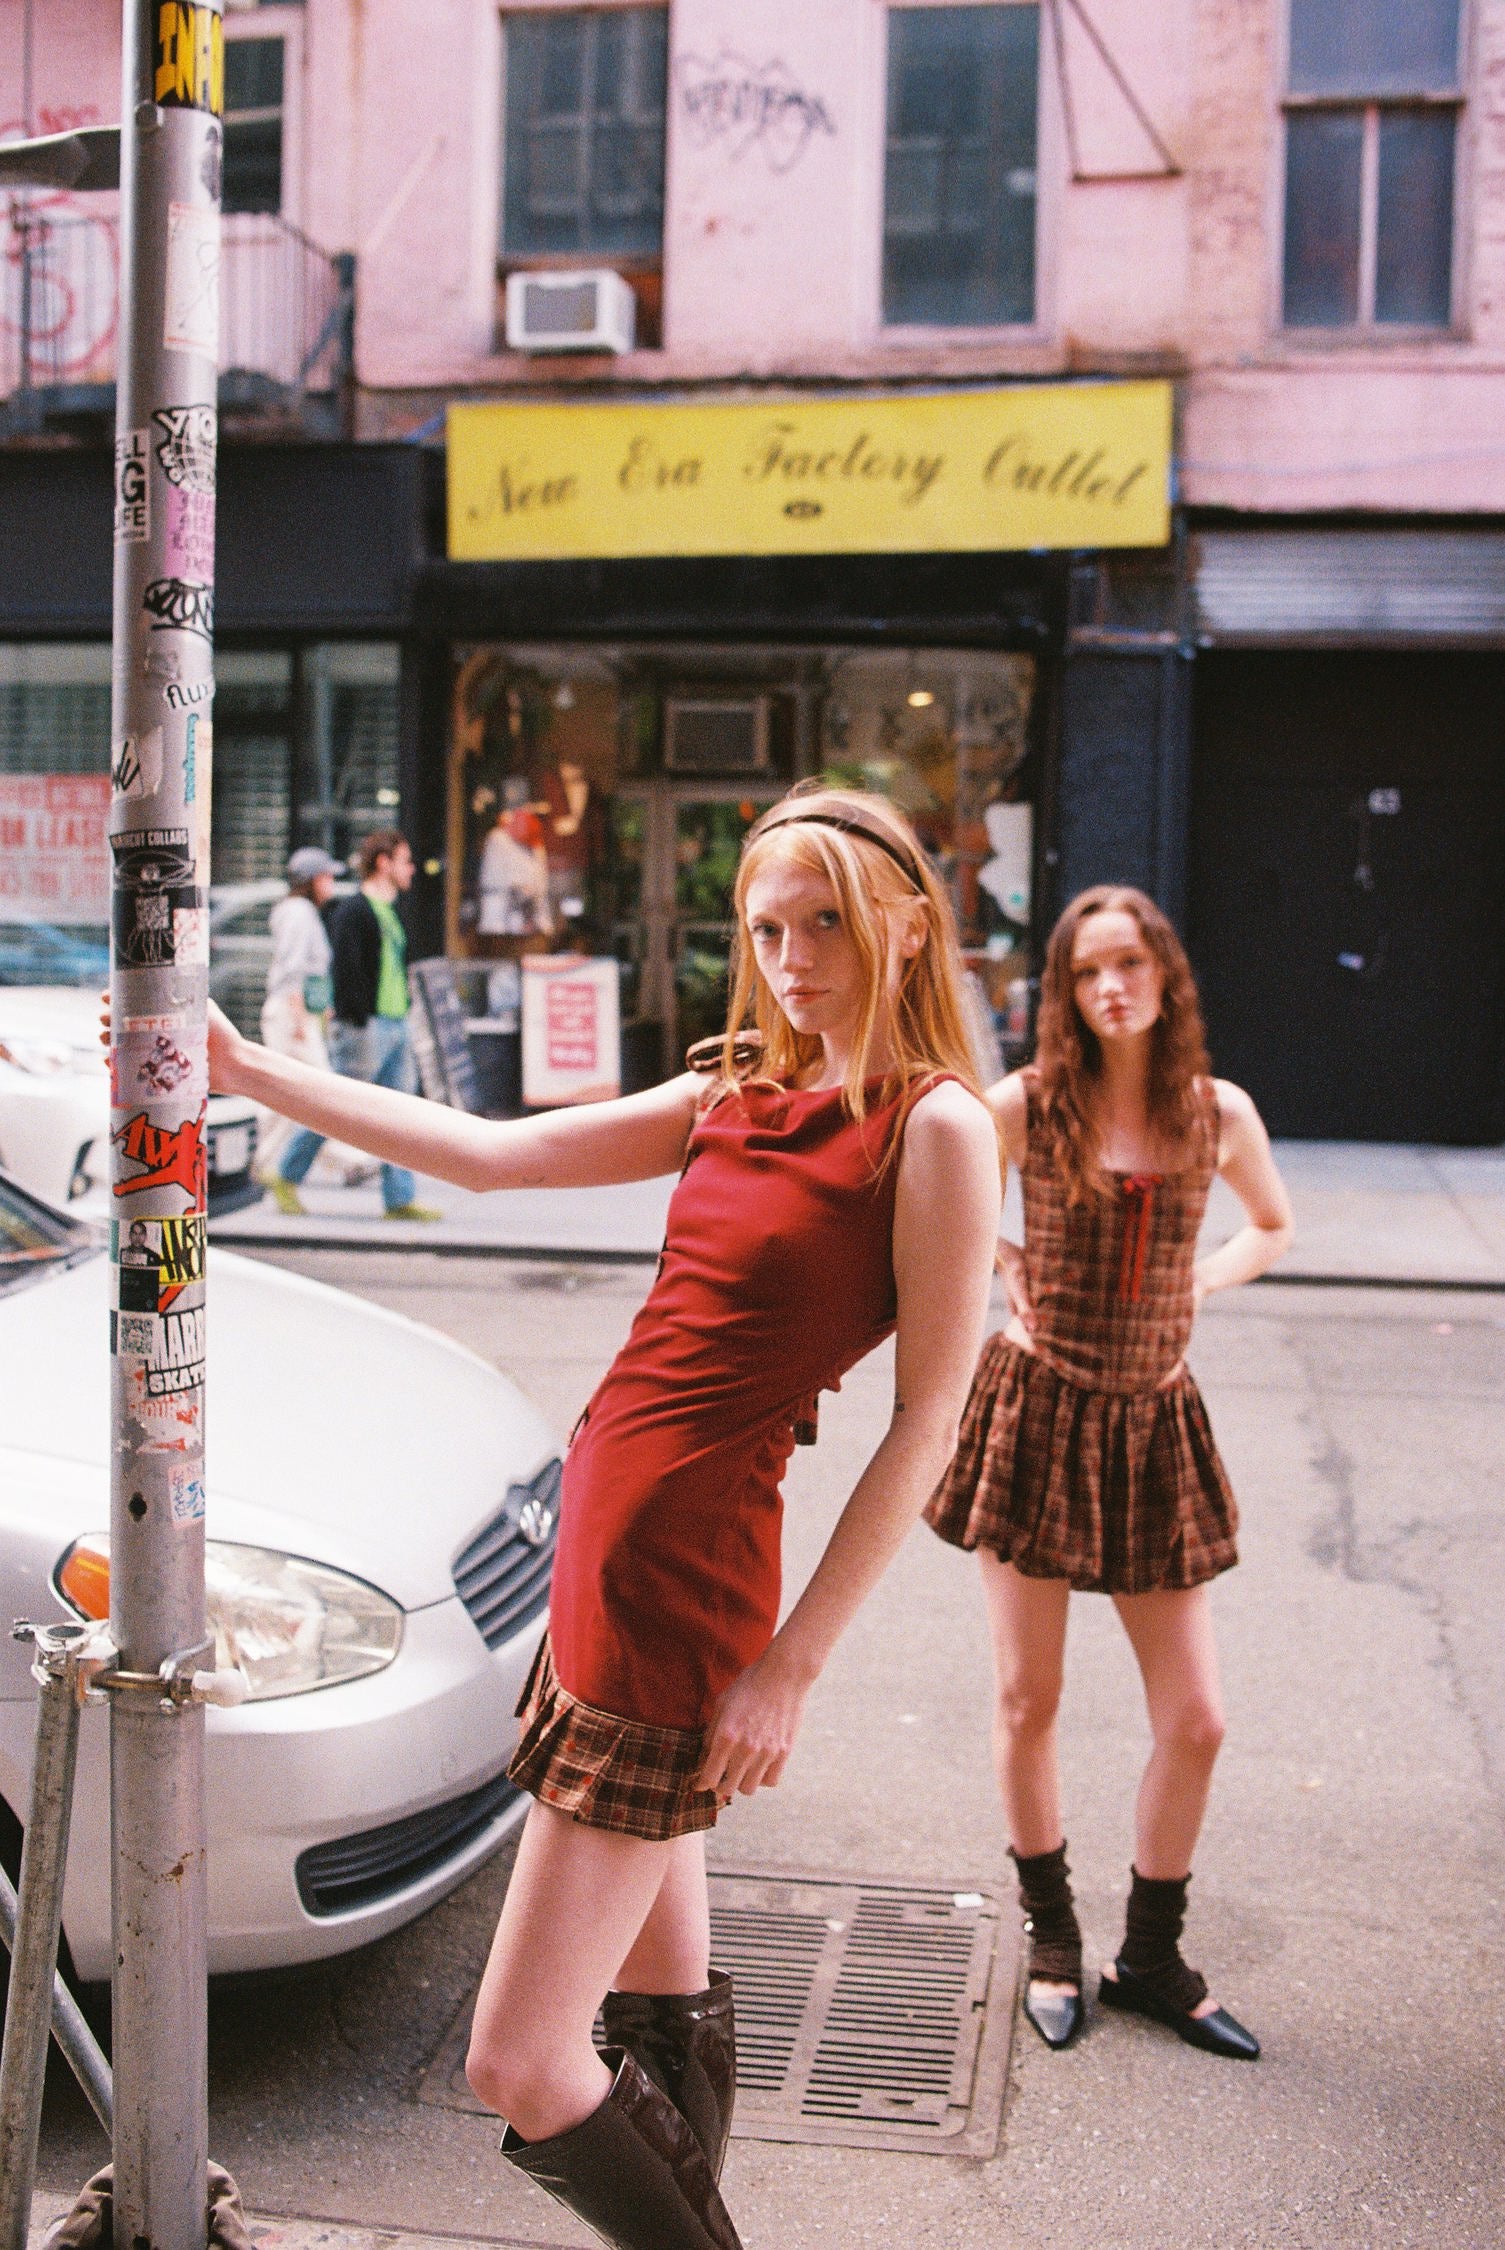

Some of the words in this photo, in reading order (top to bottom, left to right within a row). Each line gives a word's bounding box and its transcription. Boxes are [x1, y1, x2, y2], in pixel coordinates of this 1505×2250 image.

[468, 465, 578, 519] New
[618, 436, 705, 492] Era
[741, 422, 943, 505] Factory
[982, 432, 1148, 505] Outlet
[148, 1366, 205, 1394] SKAT
